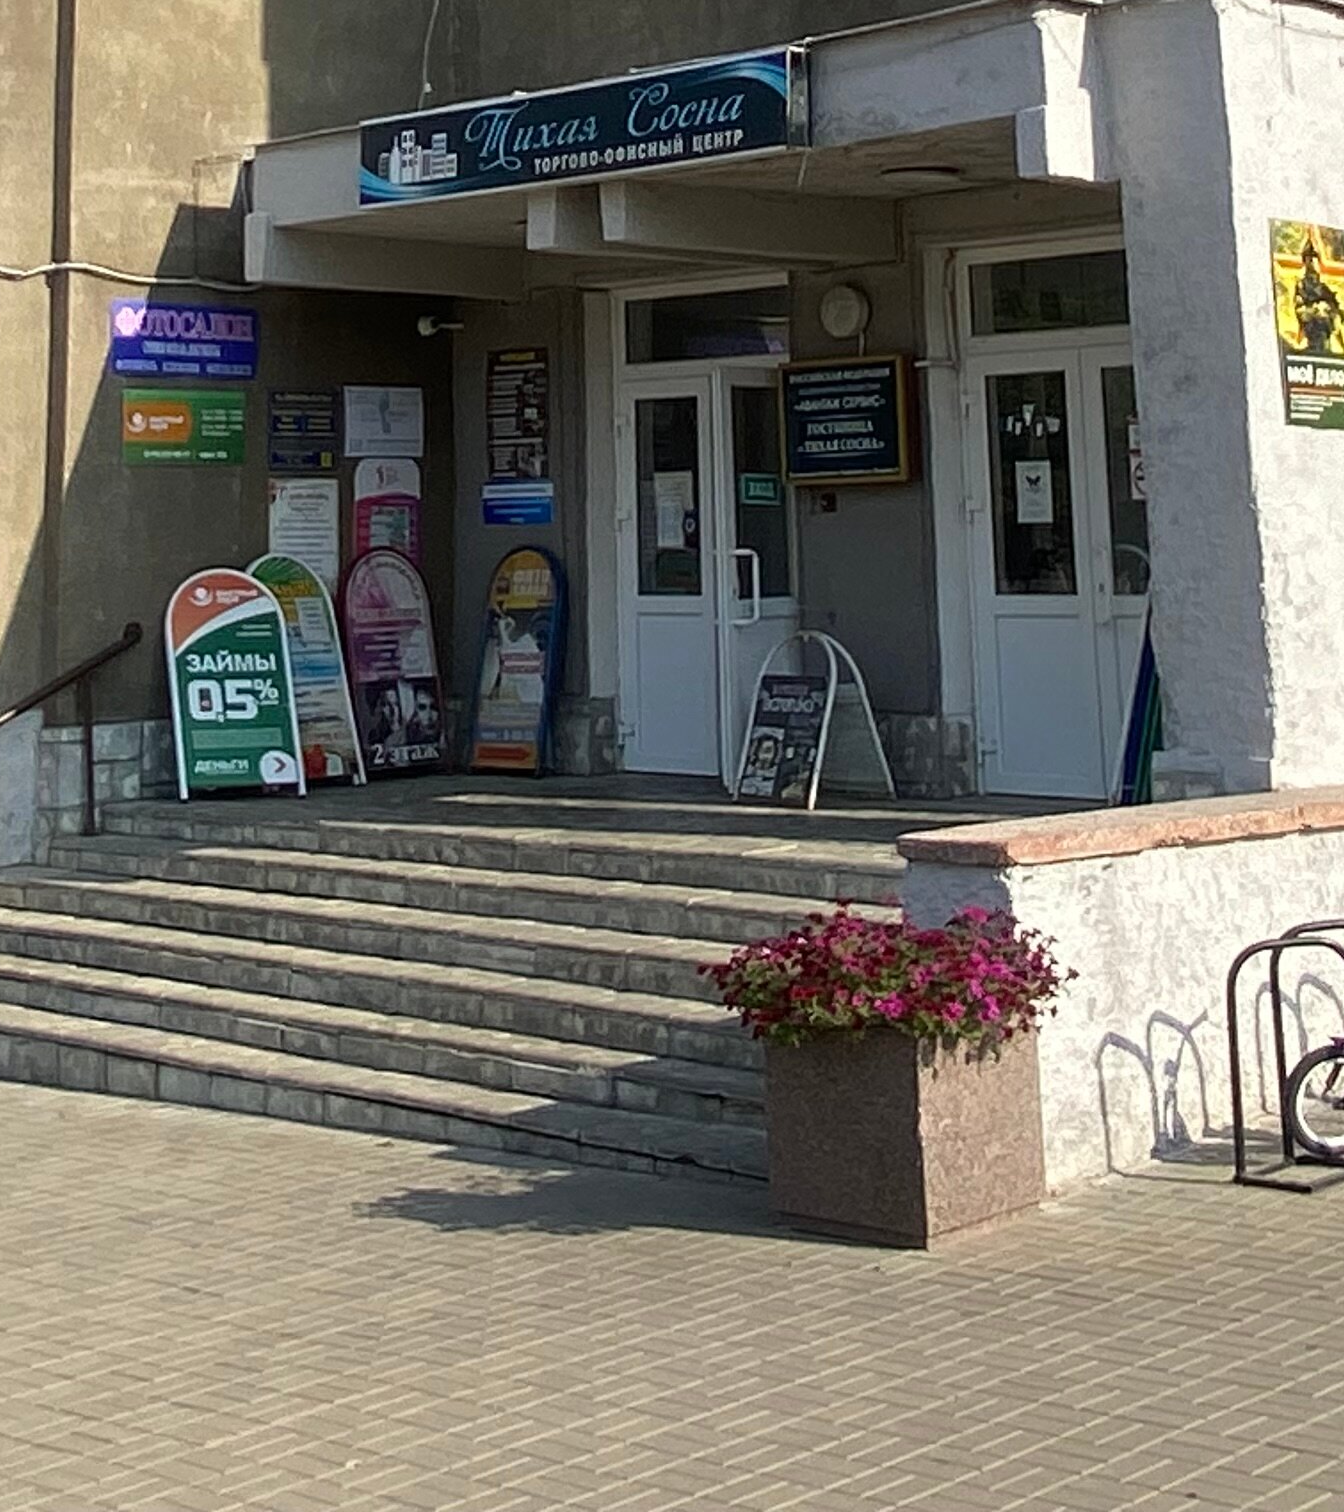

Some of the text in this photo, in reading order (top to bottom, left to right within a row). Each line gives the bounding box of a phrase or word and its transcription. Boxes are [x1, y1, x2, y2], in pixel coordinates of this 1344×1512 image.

[463, 82, 746, 172] Тихая Сосна
[534, 128, 745, 176] ТОРГОВО-ОФИСНЫЙ ЦЕНТР
[186, 649, 277, 673] ЗАЙМЫ
[194, 758, 249, 774] ДЕНЬГИ
[371, 743, 385, 765] 2
